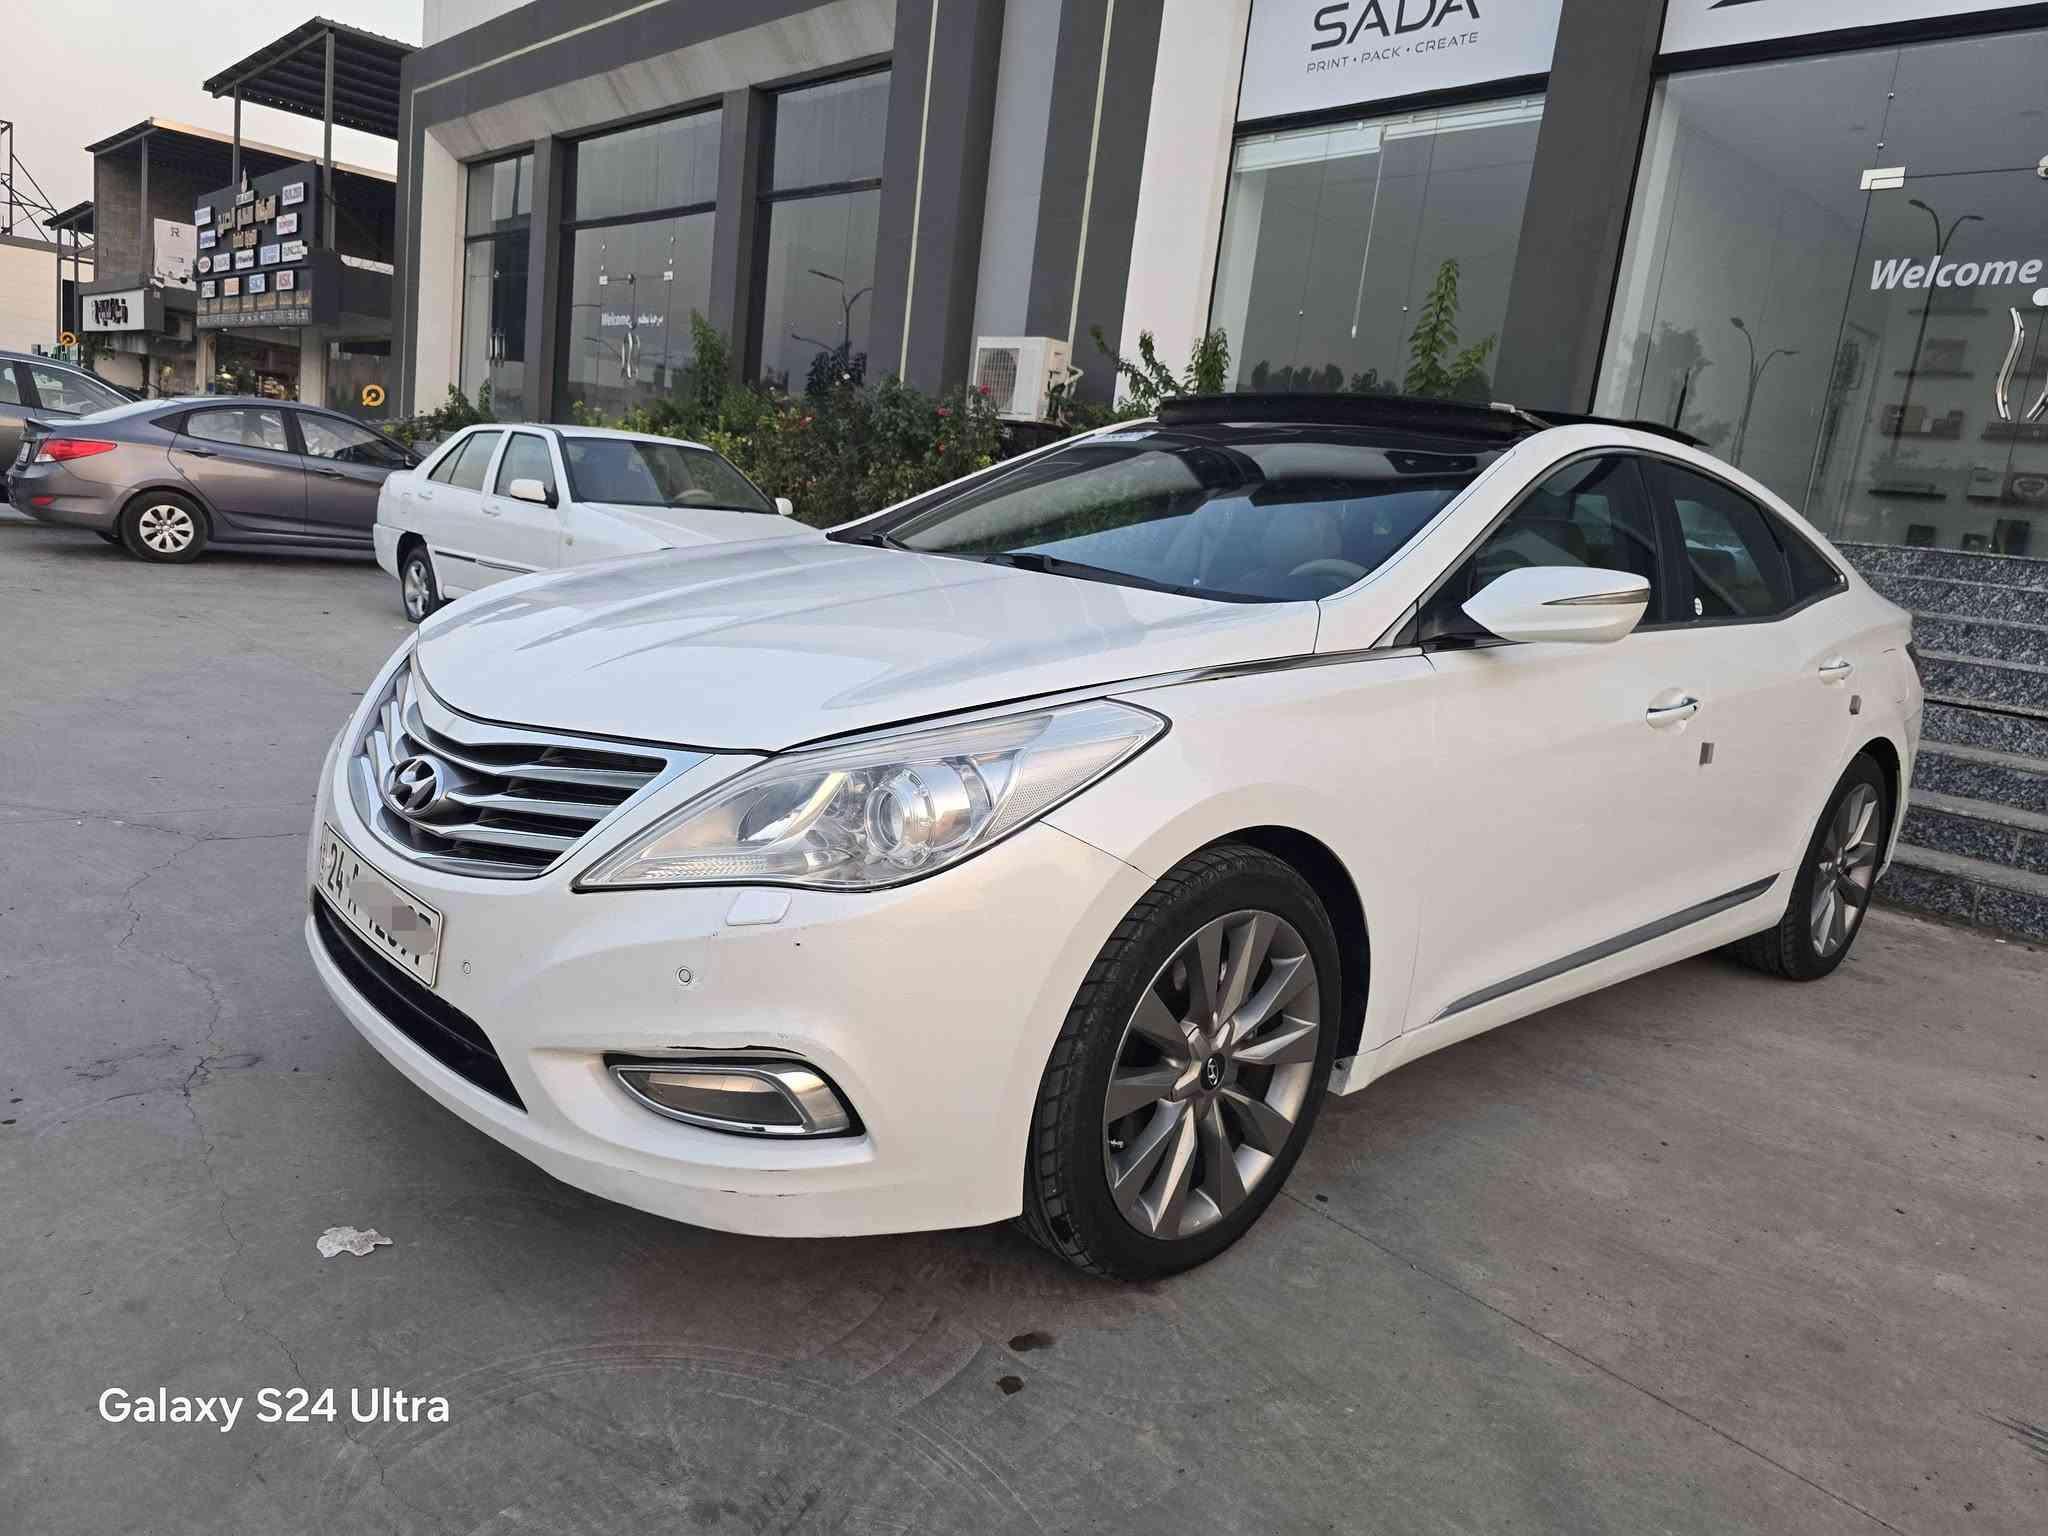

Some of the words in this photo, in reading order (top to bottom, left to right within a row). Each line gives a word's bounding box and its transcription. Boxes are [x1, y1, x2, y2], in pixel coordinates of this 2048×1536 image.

[1311, 0, 1480, 51] SADA
[1306, 56, 1349, 73] PRINT
[1361, 47, 1401, 64] PACK
[1415, 31, 1479, 54] CREATE
[1870, 255, 2043, 290] Welcome
